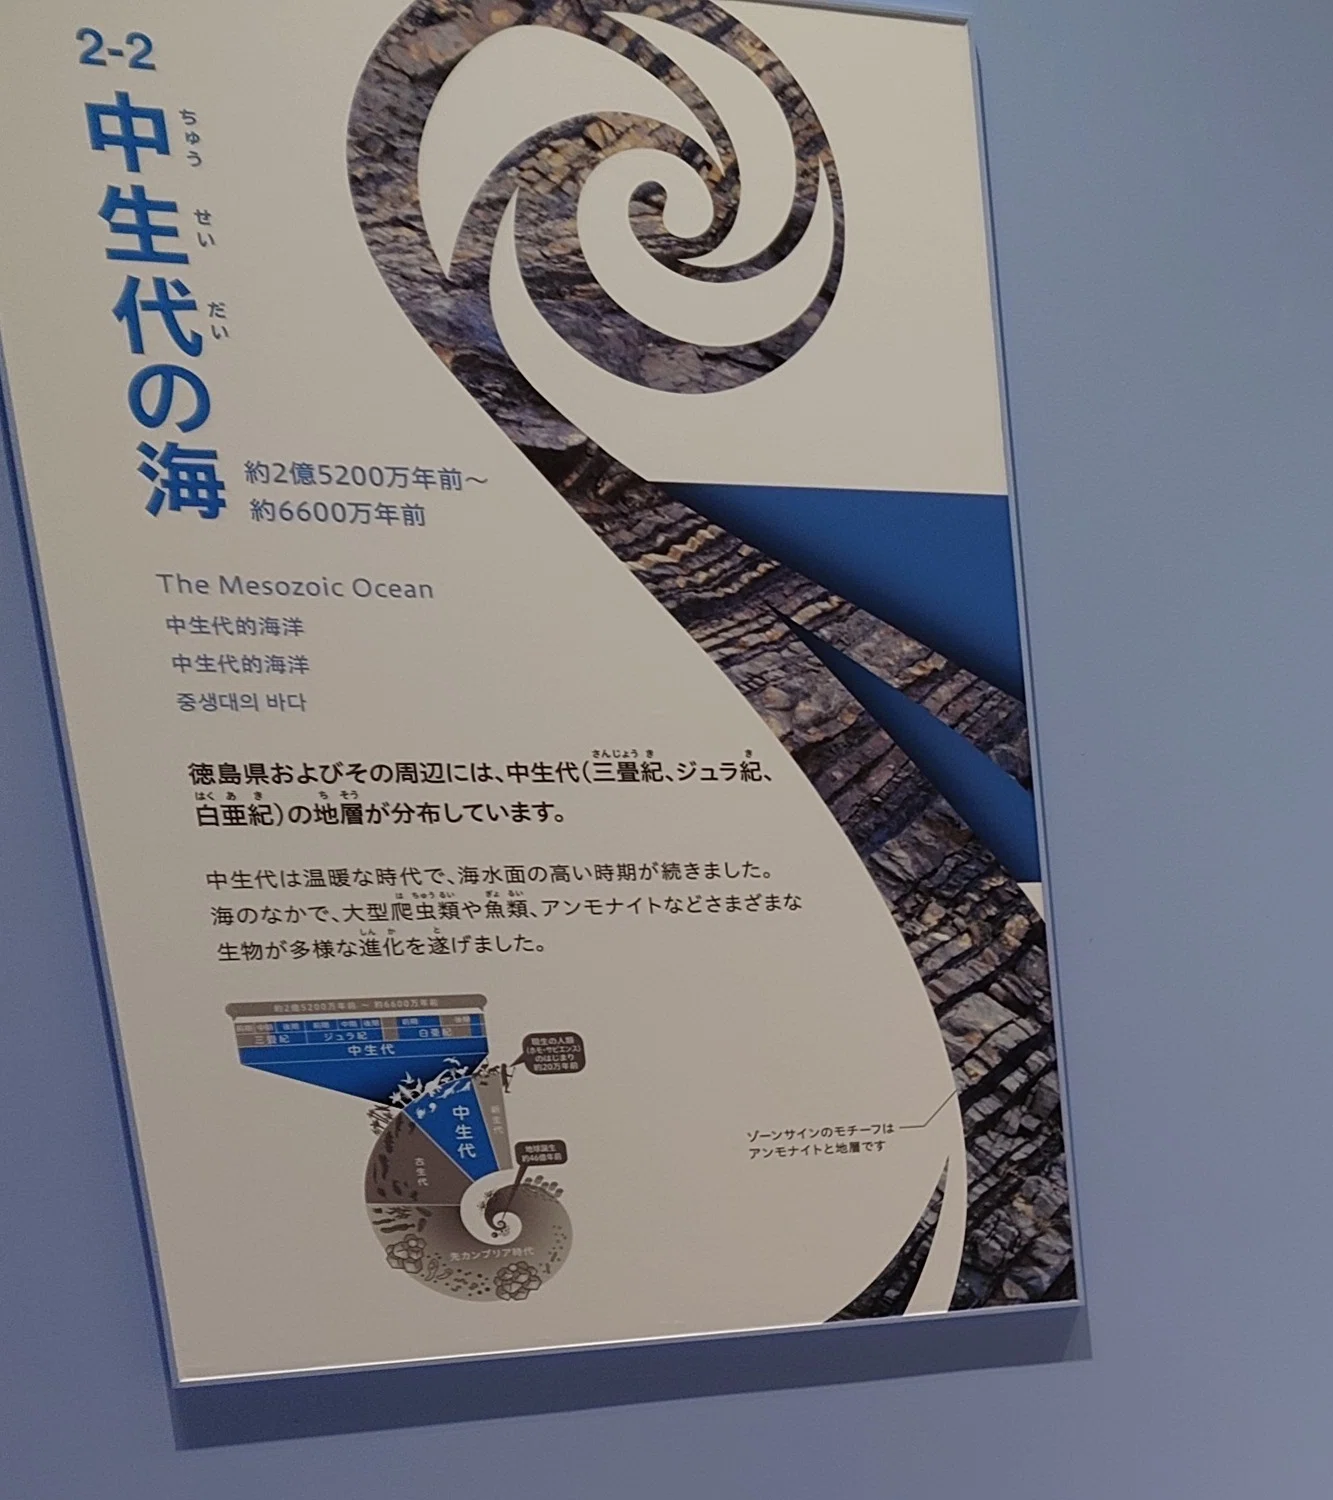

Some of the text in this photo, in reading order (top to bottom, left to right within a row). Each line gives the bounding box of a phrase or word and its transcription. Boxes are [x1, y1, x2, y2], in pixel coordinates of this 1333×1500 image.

[75, 27, 156, 71] 2-2
[84, 90, 227, 521] 中生代の海
[244, 460, 489, 492] 約2億5200万年前～
[250, 499, 426, 528] 約6600万年前
[156, 574, 434, 600] The Mesozoic Ocean
[166, 615, 304, 639] 中生代的海洋
[172, 653, 310, 676] 中生代的海洋
[176, 693, 307, 713] 중생대의 바다
[196, 801, 565, 828] 白亜紀）の地層が分布しています。
[206, 861, 772, 891] 中生代は温暖な時代で、海水面の高い時期が続きました。
[211, 894, 803, 926] 海のなかで、大型爬虫類や魚類、アンモナイトなどさまざまな
[217, 934, 548, 962] 生物が多様な進化を遂げました。
[347, 1043, 396, 1057] 中生代
[452, 1105, 477, 1159] 中生代
[747, 1123, 894, 1143] ゾーンサインのモチーフは
[749, 1140, 887, 1160] アンモナイトと地層です
